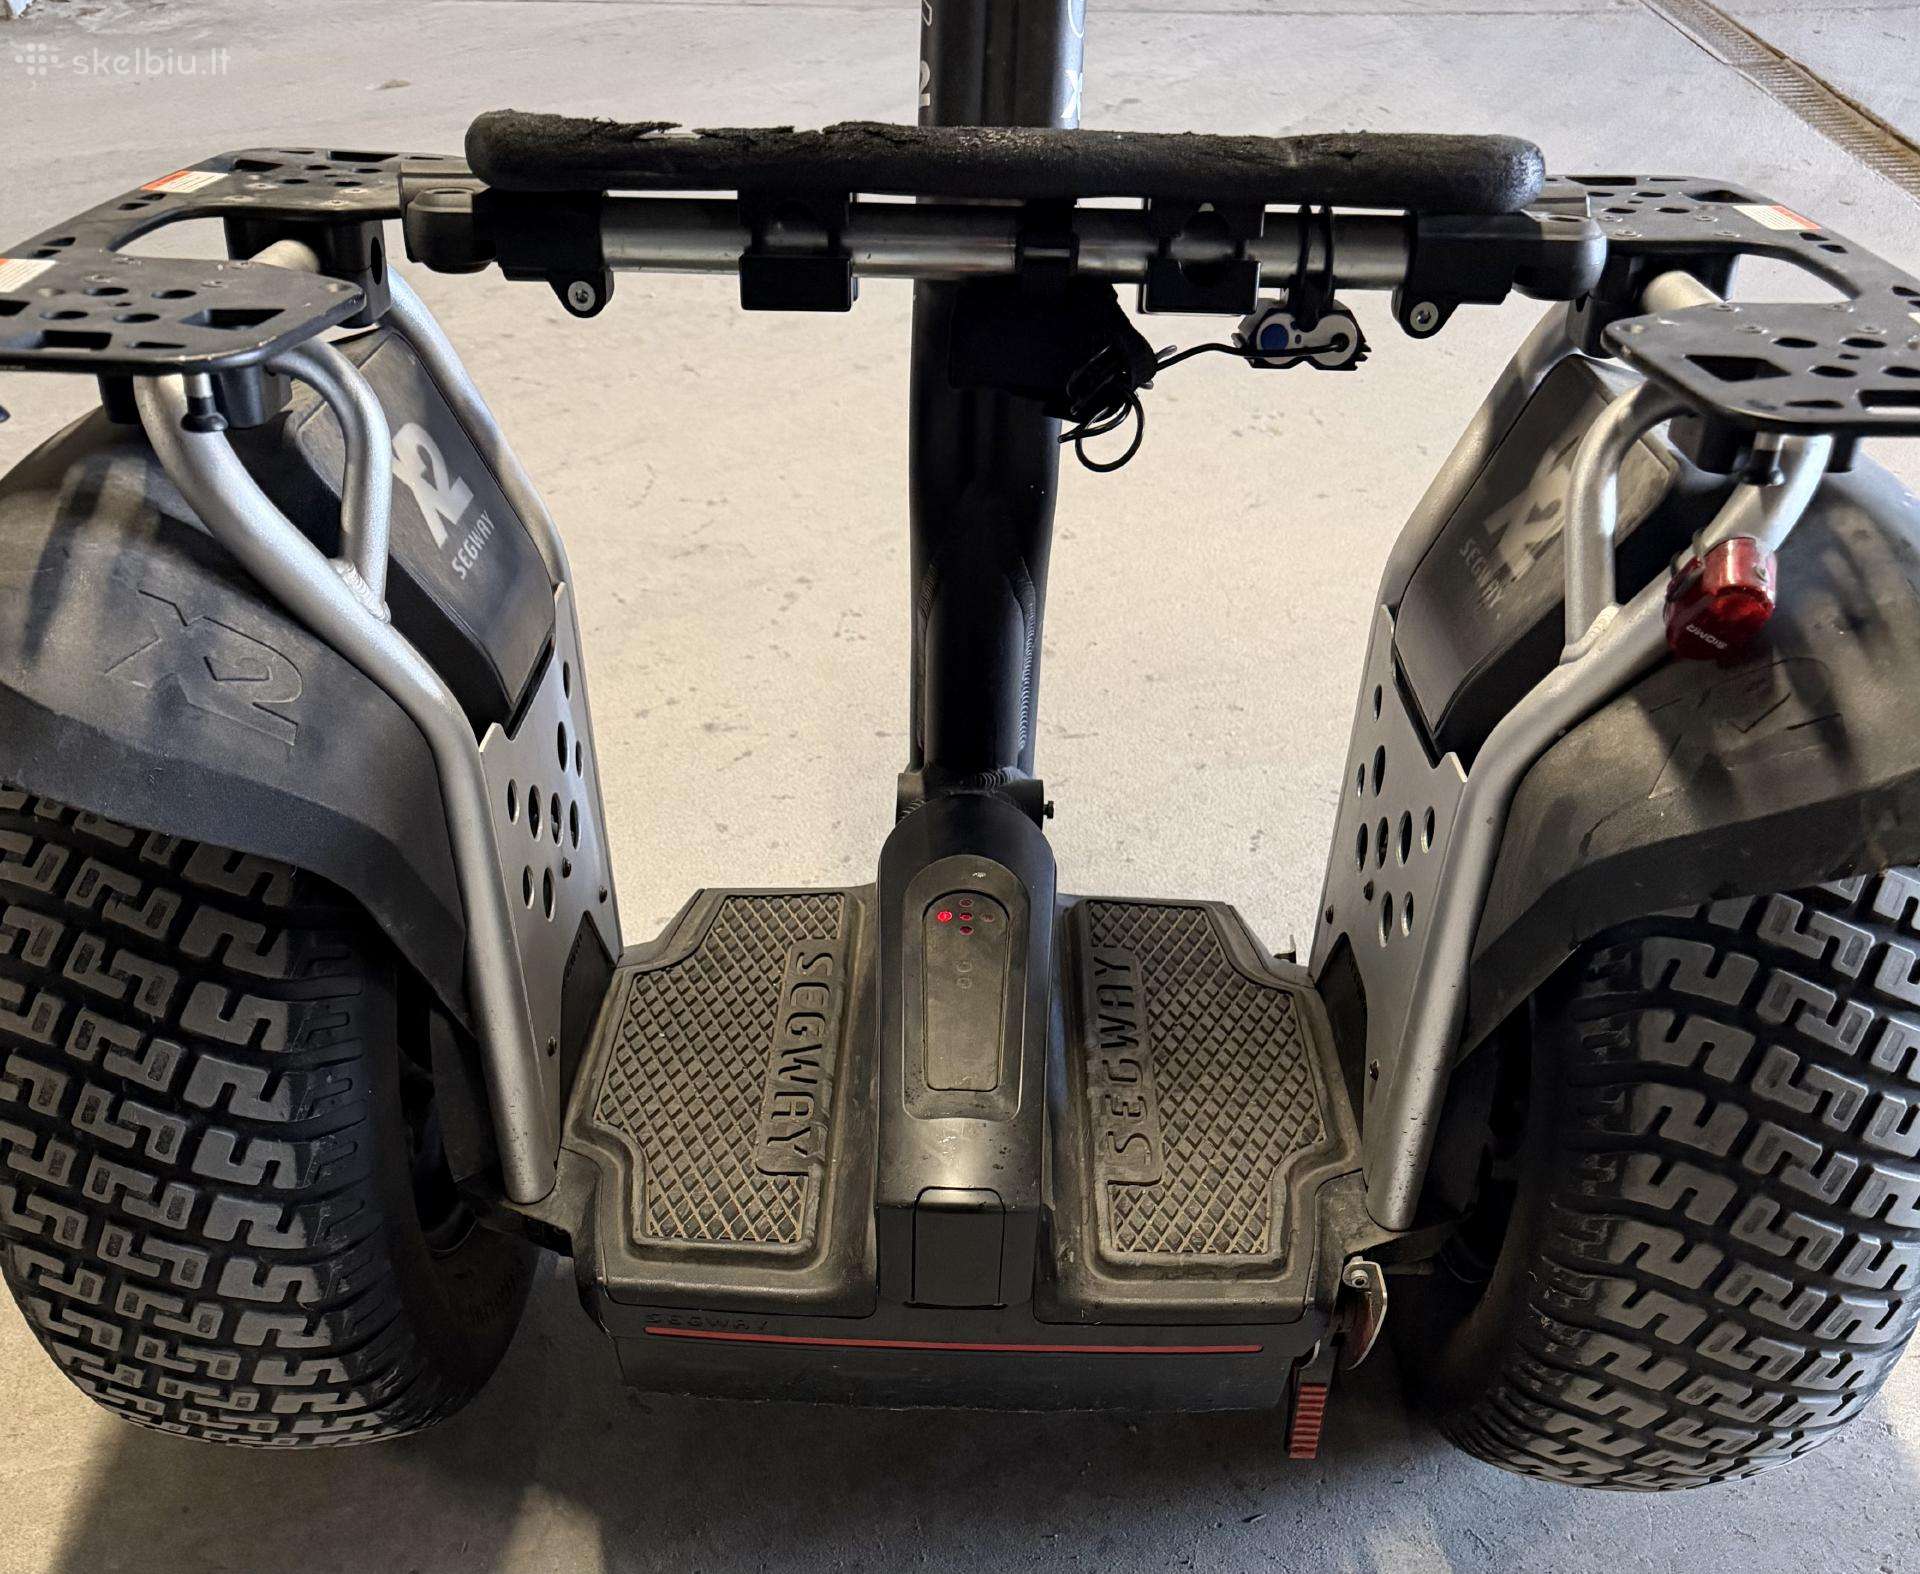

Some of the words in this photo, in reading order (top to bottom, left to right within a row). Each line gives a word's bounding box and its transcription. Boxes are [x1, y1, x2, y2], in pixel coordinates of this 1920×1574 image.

[451, 510, 495, 580] SEGWAY
[766, 950, 834, 1158] SEGWAY
[1093, 955, 1153, 1168] SEGWAY
